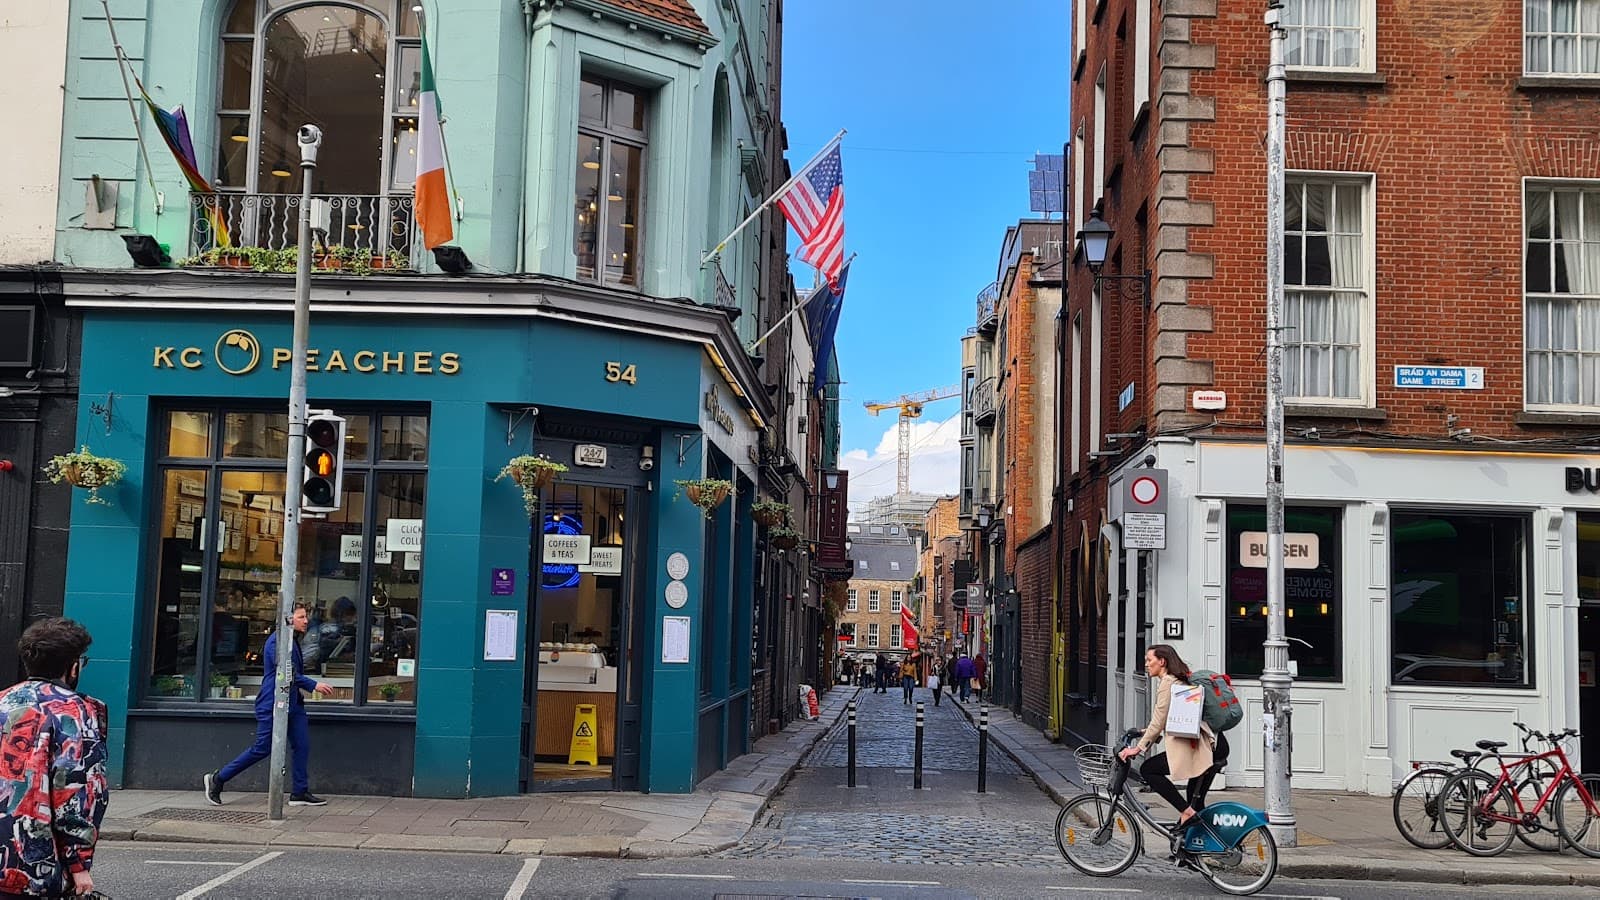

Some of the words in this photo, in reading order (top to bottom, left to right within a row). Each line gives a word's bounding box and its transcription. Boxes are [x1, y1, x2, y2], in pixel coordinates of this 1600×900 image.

[153, 346, 202, 369] KC
[271, 347, 459, 374] PEACHES
[606, 361, 637, 385] 54
[1400, 367, 1424, 376] SRÁID
[1426, 369, 1437, 377] AN
[1401, 377, 1424, 385] DAME
[1471, 373, 1478, 383] 2
[548, 540, 578, 548] COFFEES
[558, 551, 574, 559] TEAS
[1249, 543, 1309, 558] BUSEN
[1169, 623, 1178, 634] H
[1212, 813, 1248, 827] NOW
